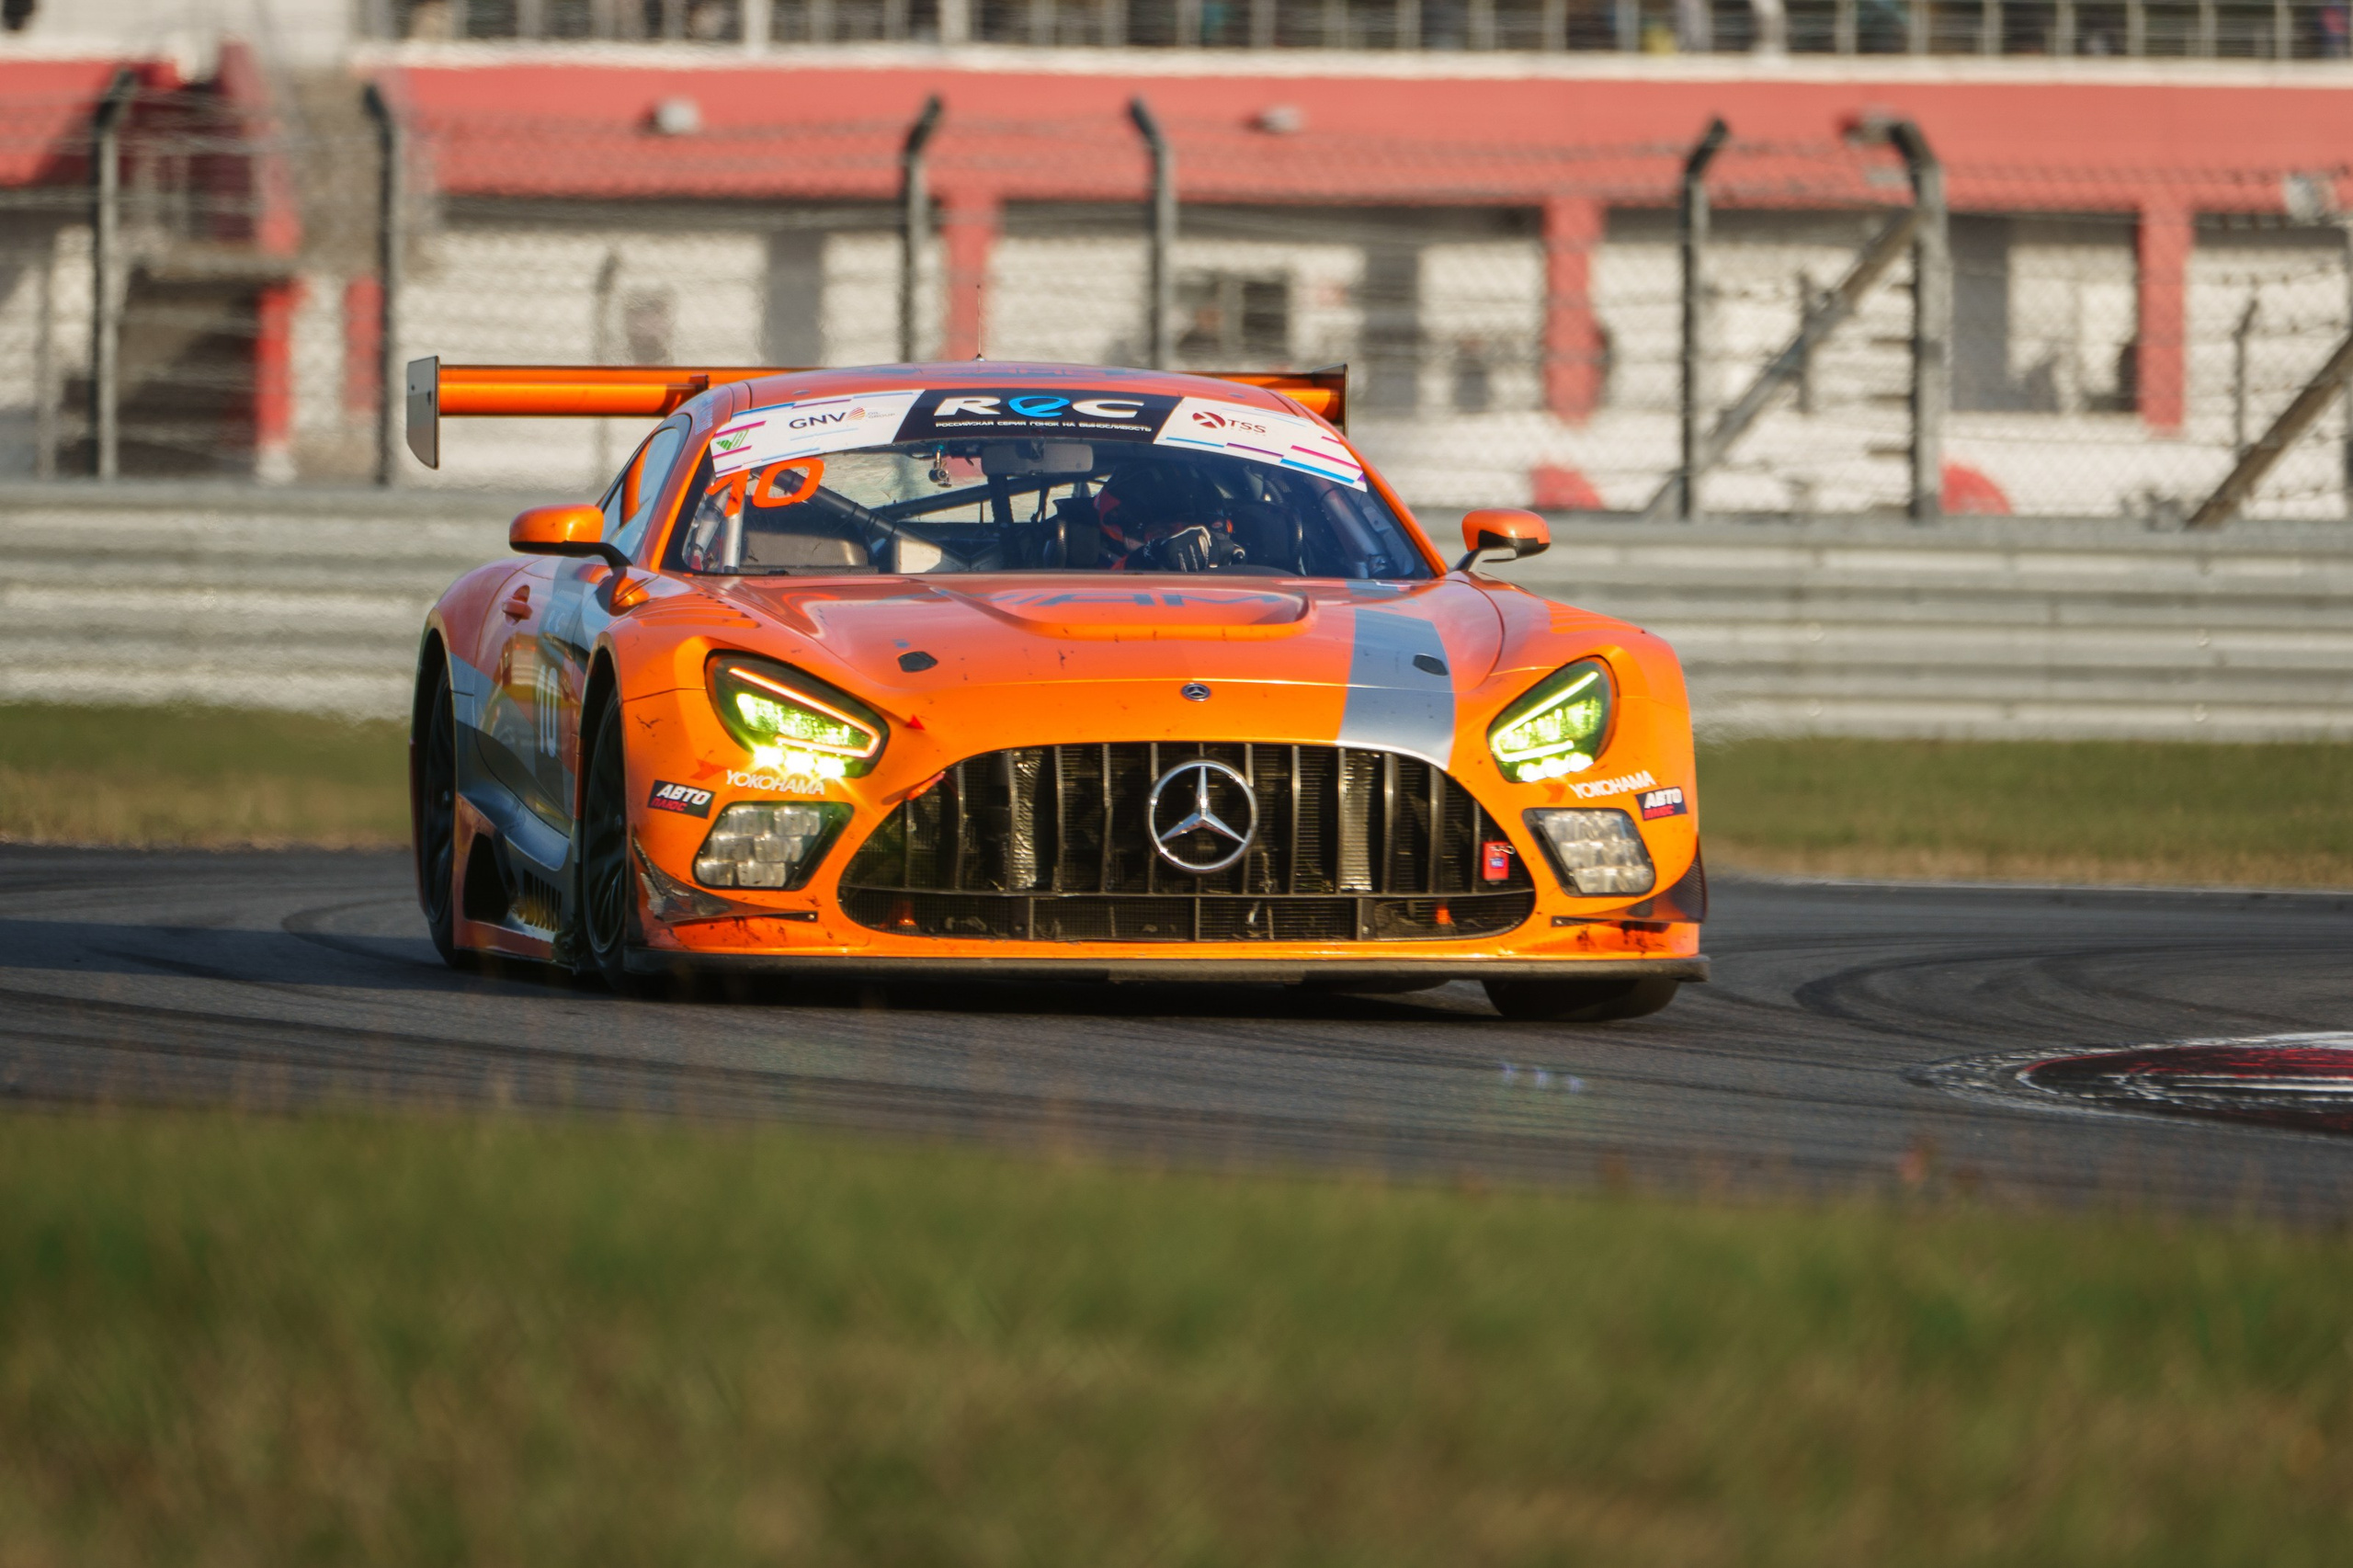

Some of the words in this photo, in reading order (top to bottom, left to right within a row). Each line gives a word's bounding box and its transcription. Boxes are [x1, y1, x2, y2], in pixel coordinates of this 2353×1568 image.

[789, 412, 847, 429] GNV
[935, 420, 995, 428] РОССИЙСКАЯ
[1227, 418, 1267, 434] TSS
[705, 457, 825, 517] 10
[536, 664, 559, 758] 10
[725, 769, 825, 796] YOKOHAMA
[1569, 769, 1657, 799] YOKOHAMA
[650, 797, 688, 812] ПЛЮС
[655, 783, 712, 806] АВТО
